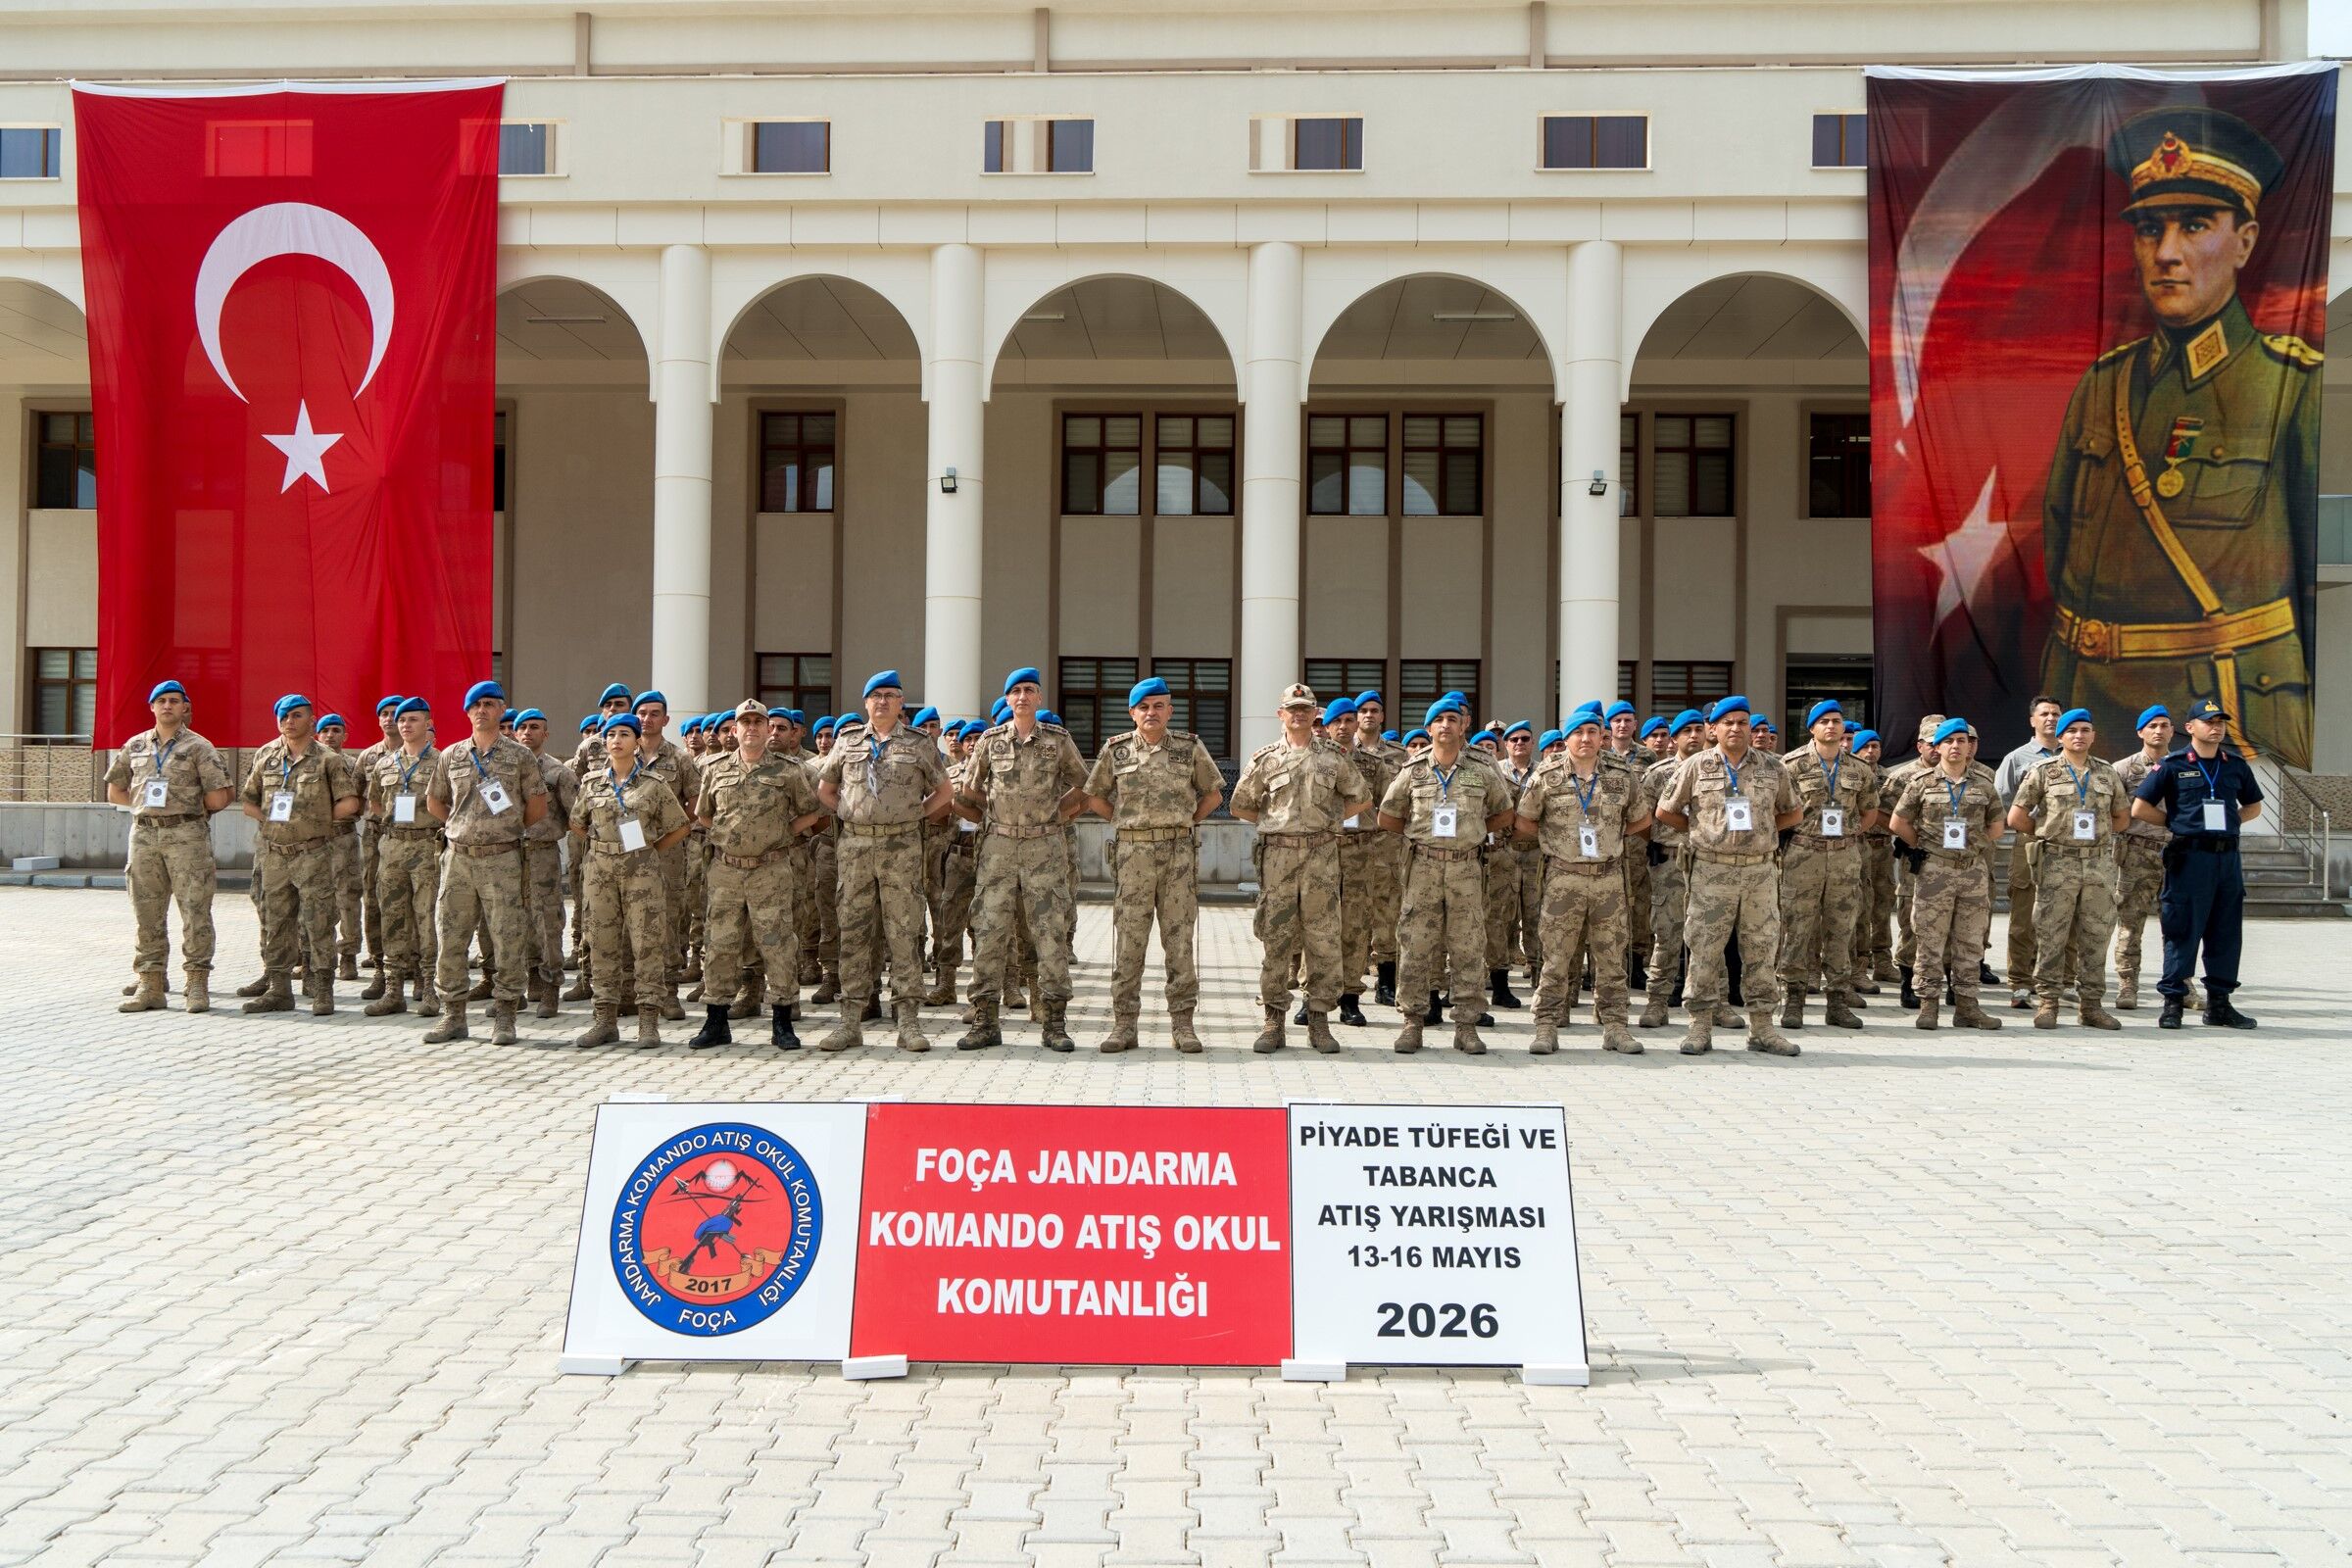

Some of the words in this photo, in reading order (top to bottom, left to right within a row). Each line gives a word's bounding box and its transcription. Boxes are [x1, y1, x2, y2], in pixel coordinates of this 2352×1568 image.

[711, 1131, 753, 1151] ATIŞ
[1300, 1120, 1399, 1148] PİYADE
[1407, 1122, 1510, 1149] TÜFEĞİ
[1518, 1128, 1556, 1150] VE
[627, 1134, 707, 1206] KOMANDO
[756, 1141, 797, 1181] OKUL
[915, 1148, 1017, 1193] FOÇA
[1027, 1150, 1238, 1186] JANDARMA
[1362, 1165, 1497, 1188] TABANCA
[869, 1210, 1064, 1250] KOMANDO
[1075, 1214, 1162, 1260] ATIŞ
[1173, 1214, 1281, 1251] OKUL
[1317, 1204, 1381, 1233] ATIŞ
[1390, 1205, 1545, 1234] YARIŞMASI
[619, 1209, 662, 1307] JANDARMA
[759, 1179, 810, 1307] KOMUTANLIĞI
[1348, 1245, 1423, 1268] 13-16
[1432, 1247, 1521, 1269] MAYIS
[685, 1278, 732, 1294] 2017
[937, 1272, 1208, 1318] KOMUTANLIĞI
[678, 1309, 737, 1332] FOÇA
[1377, 1302, 1499, 1339] 2026
